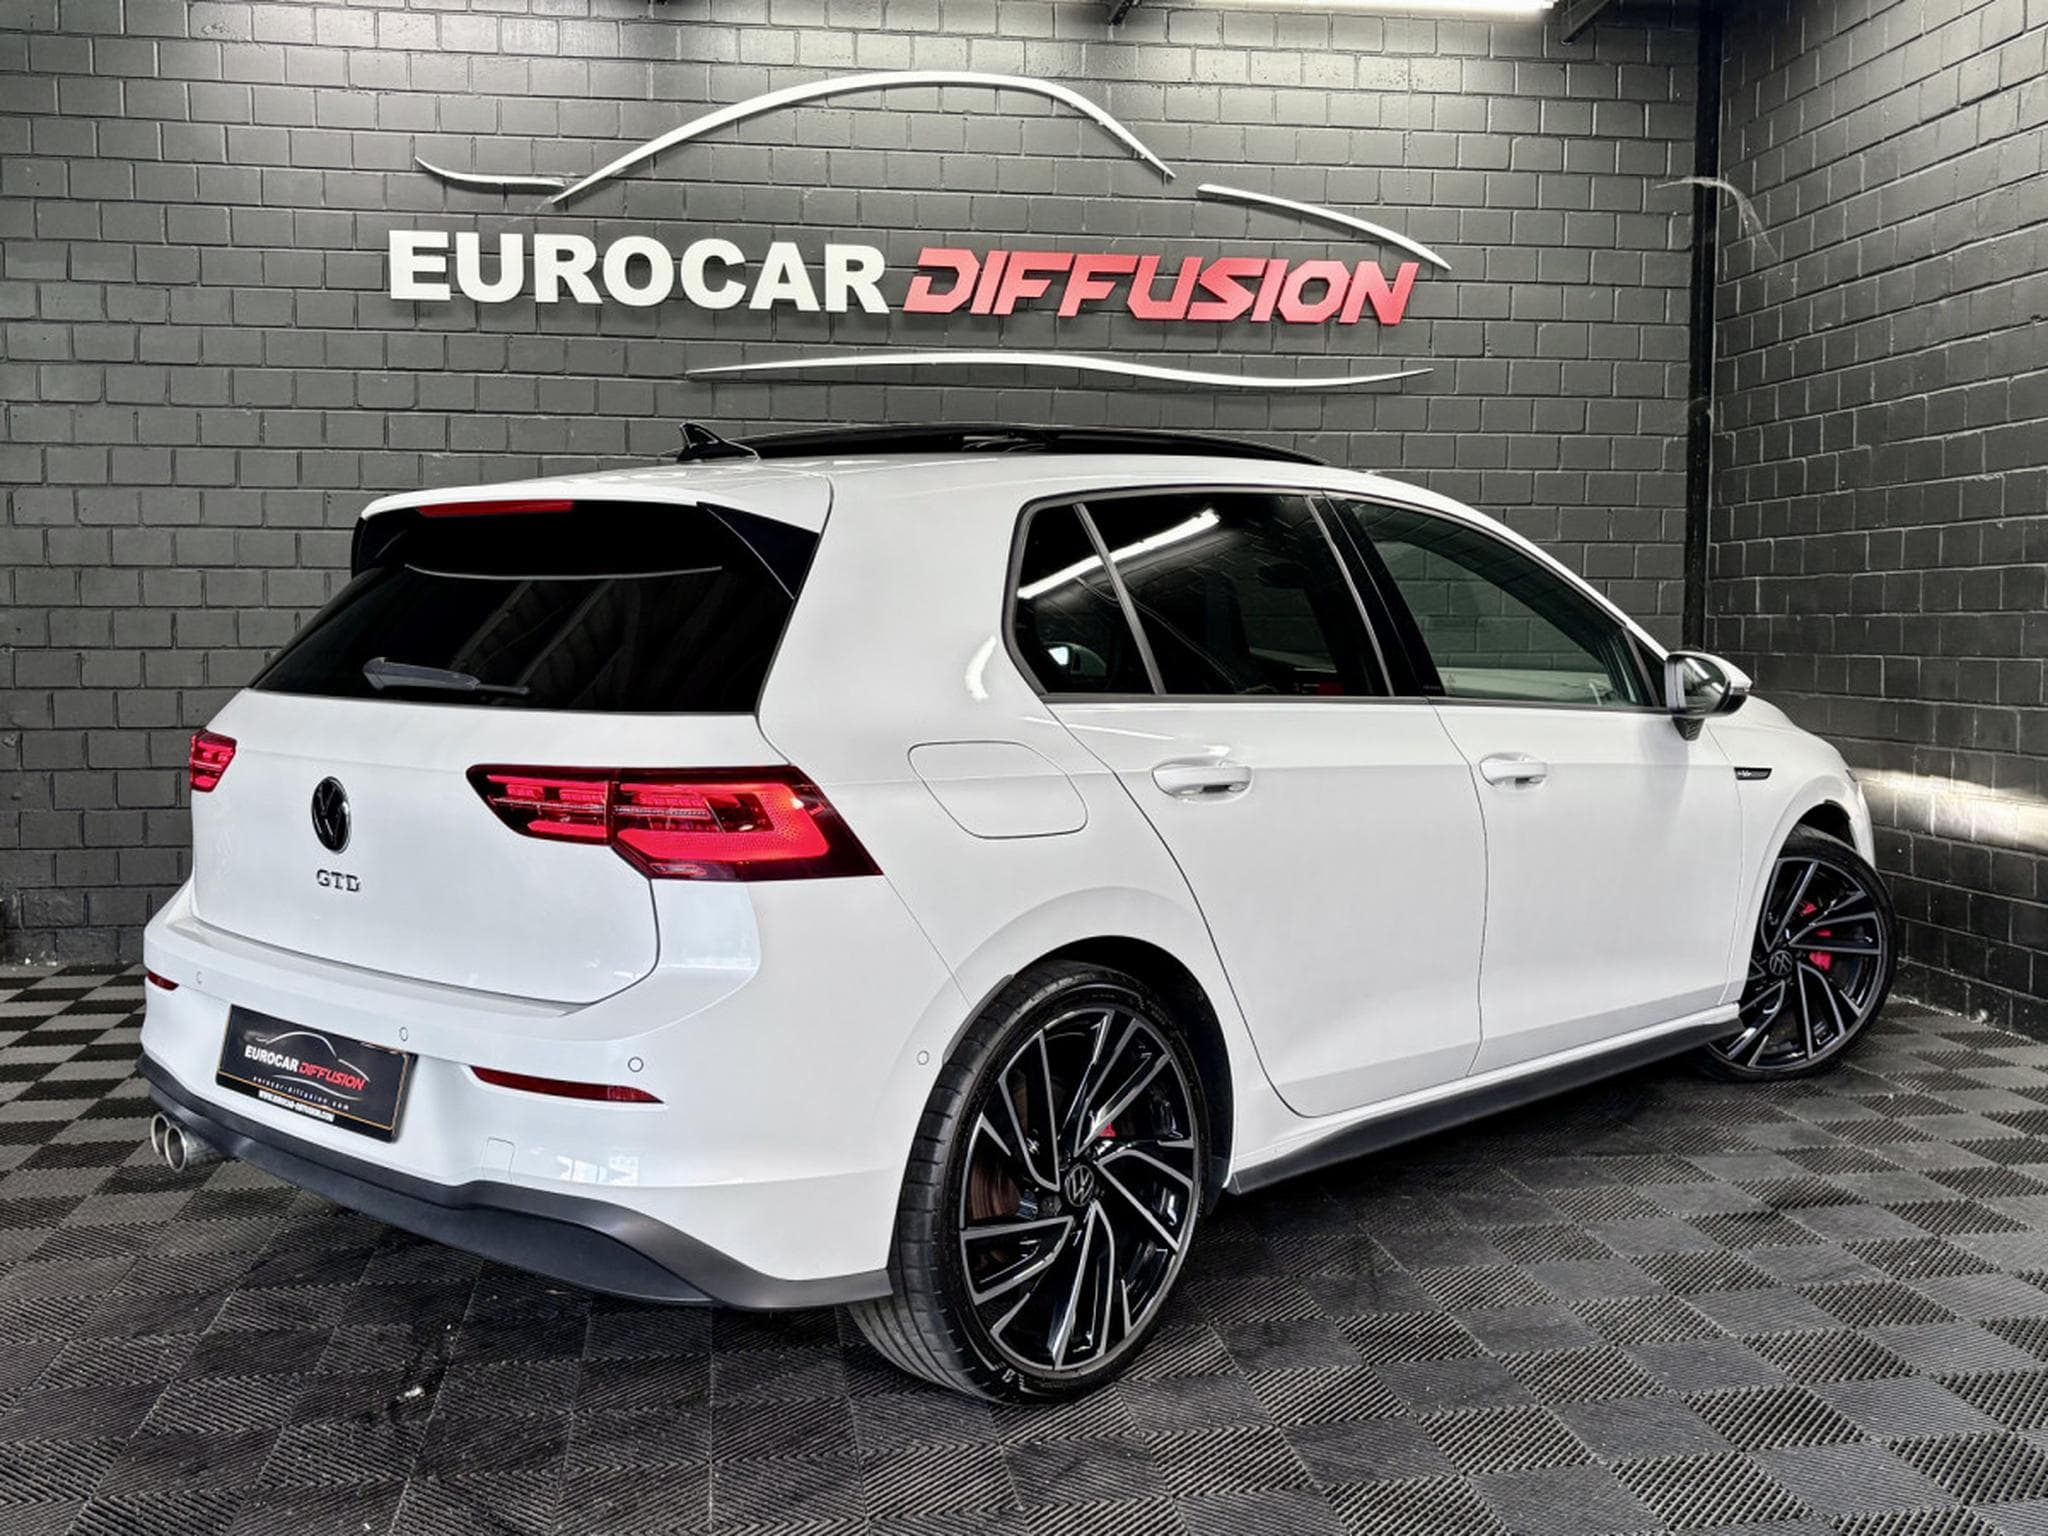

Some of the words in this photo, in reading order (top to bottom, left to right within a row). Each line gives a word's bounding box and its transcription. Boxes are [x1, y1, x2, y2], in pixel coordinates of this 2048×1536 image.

[388, 230, 890, 314] EUROCAR
[903, 247, 1420, 326] DIFFUSION
[316, 869, 361, 892] GTD
[244, 1045, 299, 1072] EUROCAR
[299, 1062, 366, 1091] DIFFUSION
